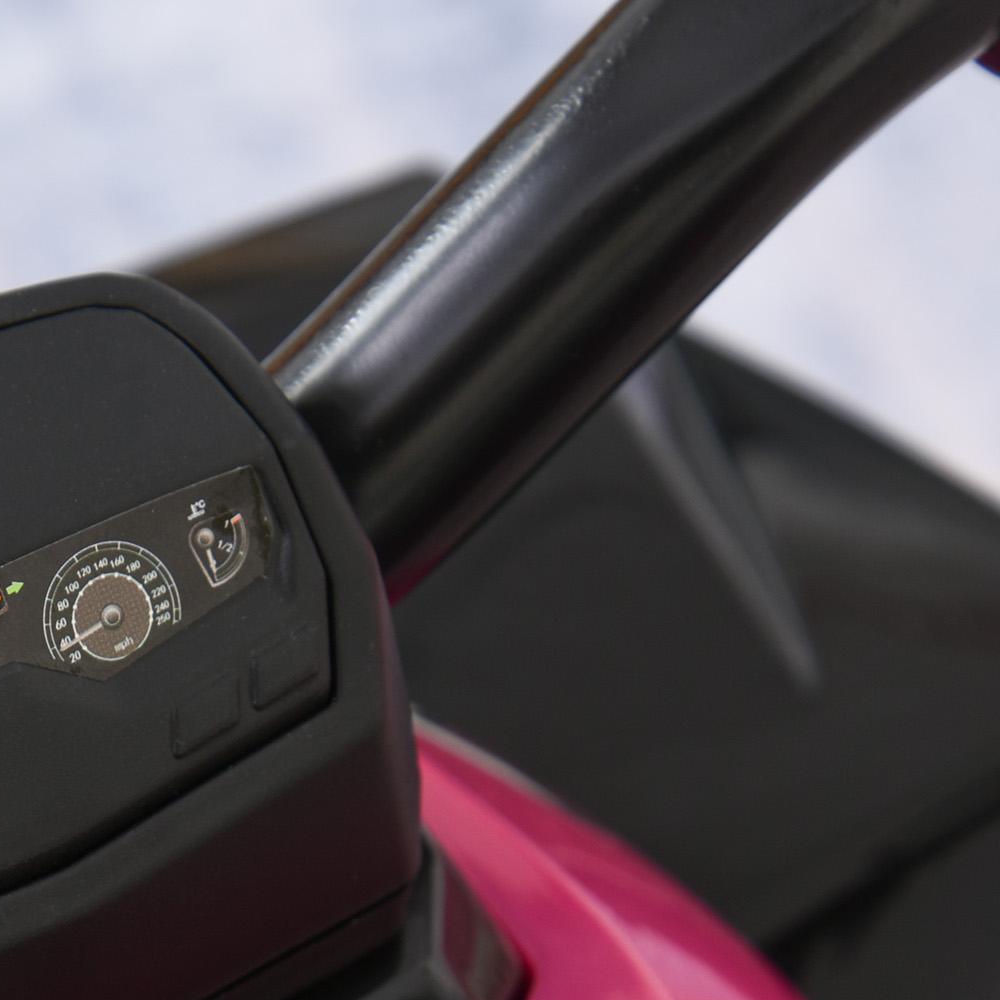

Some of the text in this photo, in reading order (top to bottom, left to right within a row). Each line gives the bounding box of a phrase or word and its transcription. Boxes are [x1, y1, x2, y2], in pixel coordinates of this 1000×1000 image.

[218, 540, 233, 553] 1/2
[93, 557, 109, 571] 140
[109, 555, 125, 569] 160
[125, 560, 141, 574] 180
[76, 565, 92, 579] 120
[142, 570, 158, 584] 200
[64, 581, 79, 594] 100
[151, 585, 167, 599] 220
[57, 599, 69, 612] 80
[154, 600, 170, 614] 240
[55, 617, 67, 630] 60
[69, 650, 81, 664] 20
